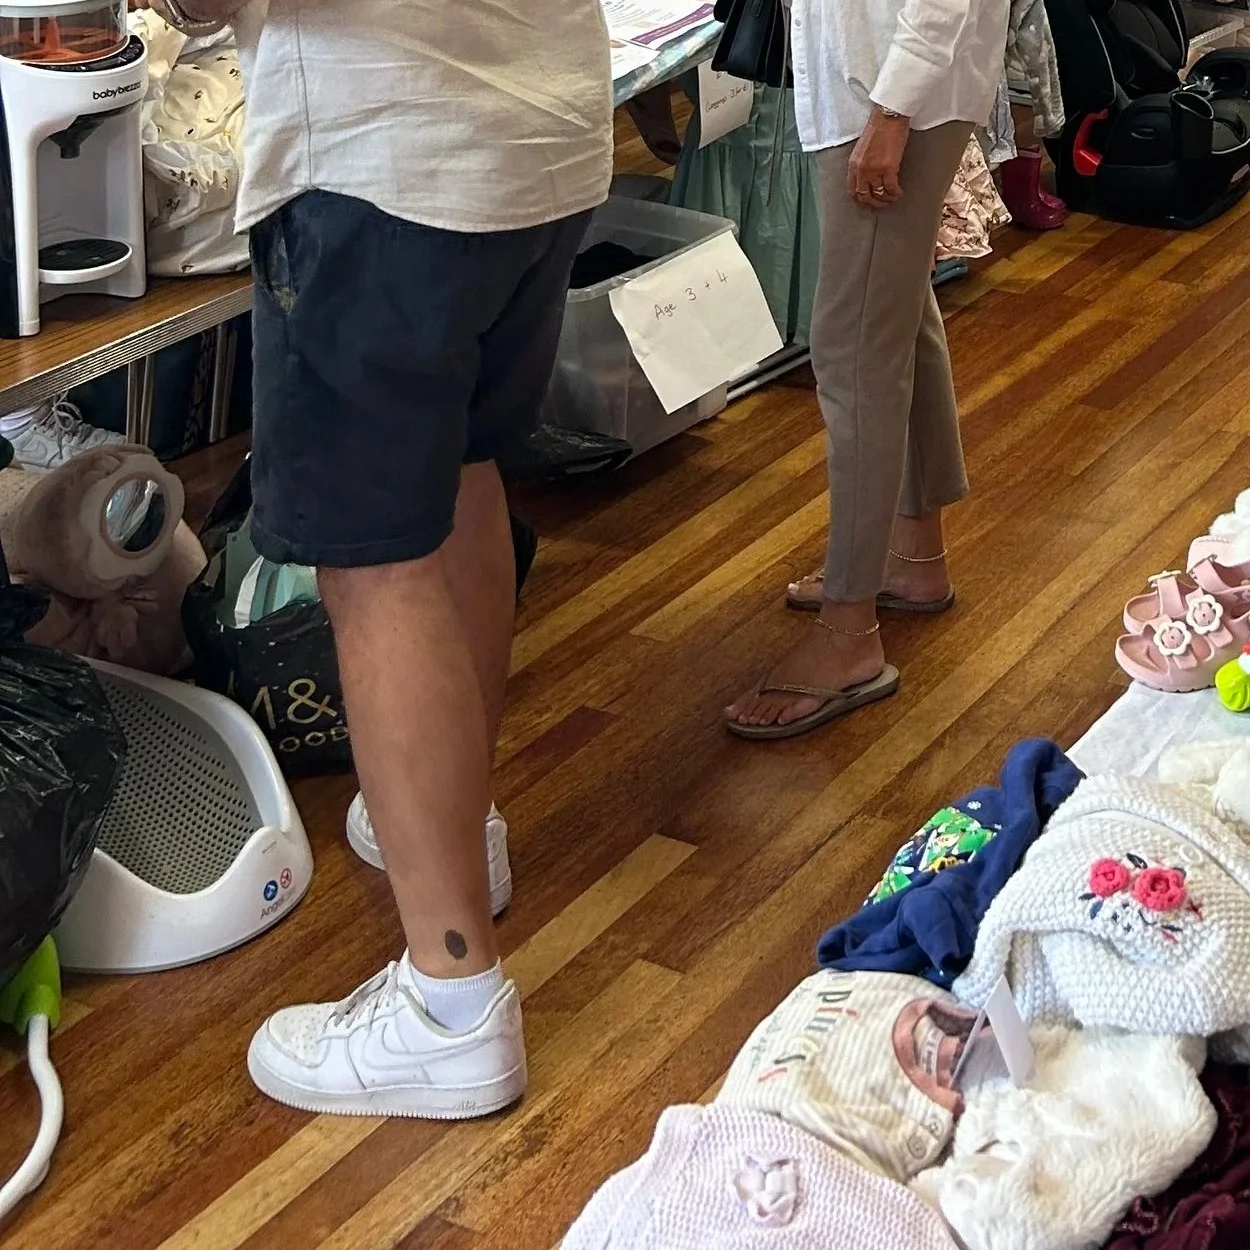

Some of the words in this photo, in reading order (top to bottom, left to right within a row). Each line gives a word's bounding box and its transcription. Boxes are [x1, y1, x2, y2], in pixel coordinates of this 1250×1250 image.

[654, 303, 676, 320] Age
[685, 287, 696, 301] 3
[716, 269, 728, 284] 4
